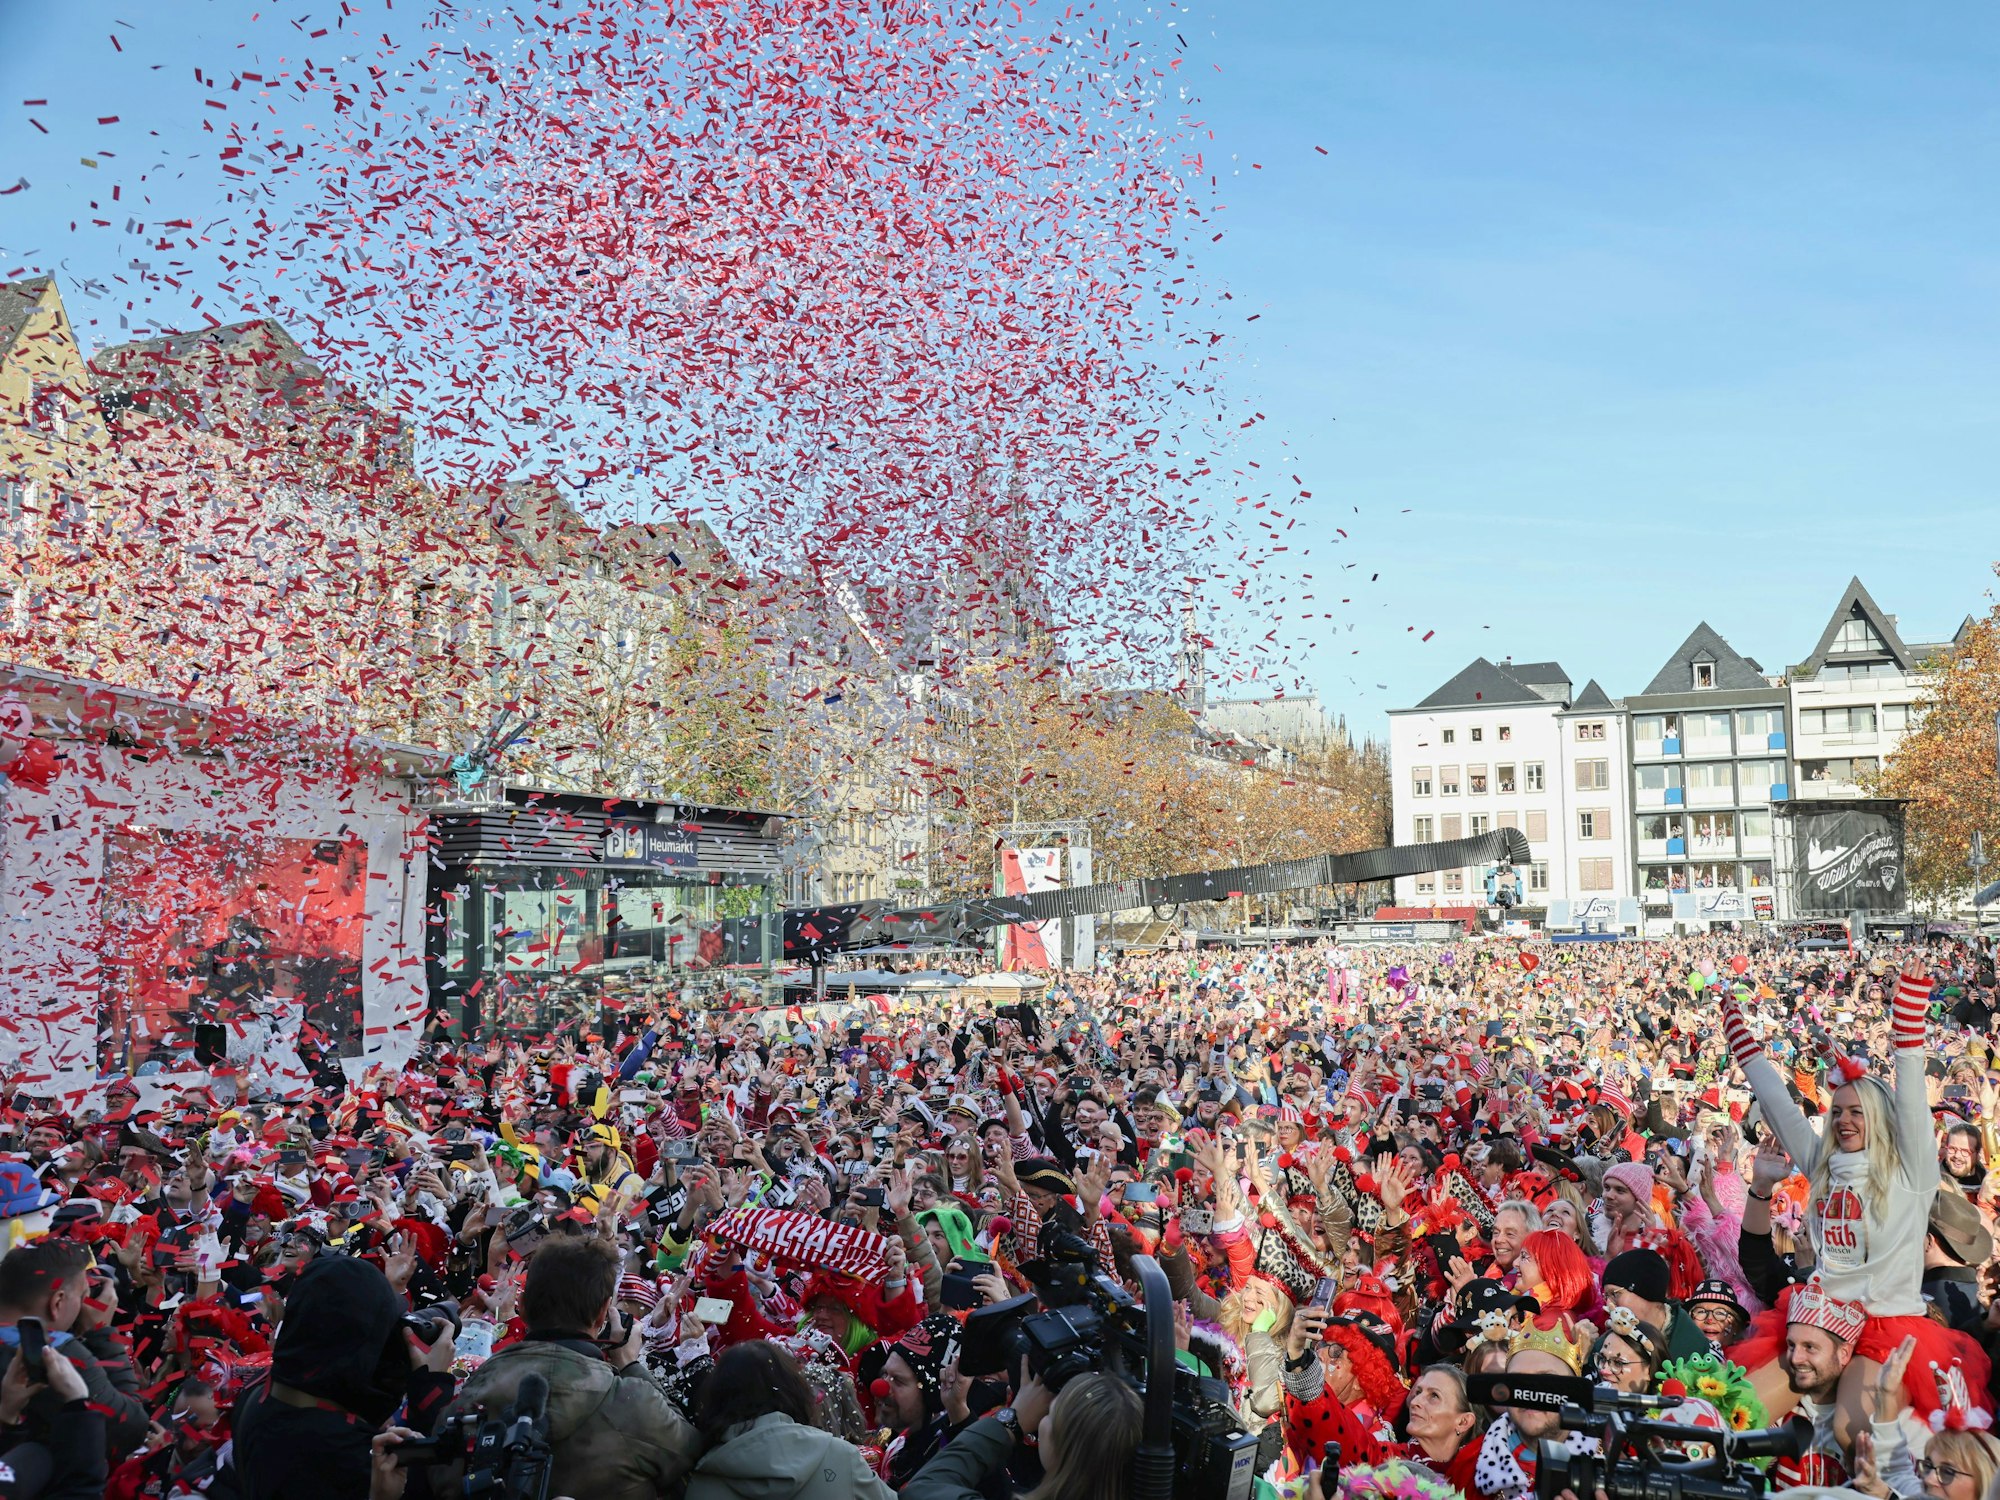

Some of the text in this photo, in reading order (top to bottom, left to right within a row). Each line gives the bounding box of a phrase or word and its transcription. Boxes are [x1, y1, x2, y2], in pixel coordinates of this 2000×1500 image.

[650, 837, 694, 853] Heumarkt
[1817, 862, 1848, 890] Willi
[1577, 897, 1612, 917] Sion
[1704, 890, 1741, 912] Sion
[1824, 1223, 1857, 1249] rüh
[1513, 1388, 1569, 1405] REUTERS
[1234, 1456, 1251, 1469] WDR
[1722, 1485, 1748, 1494] SONY
